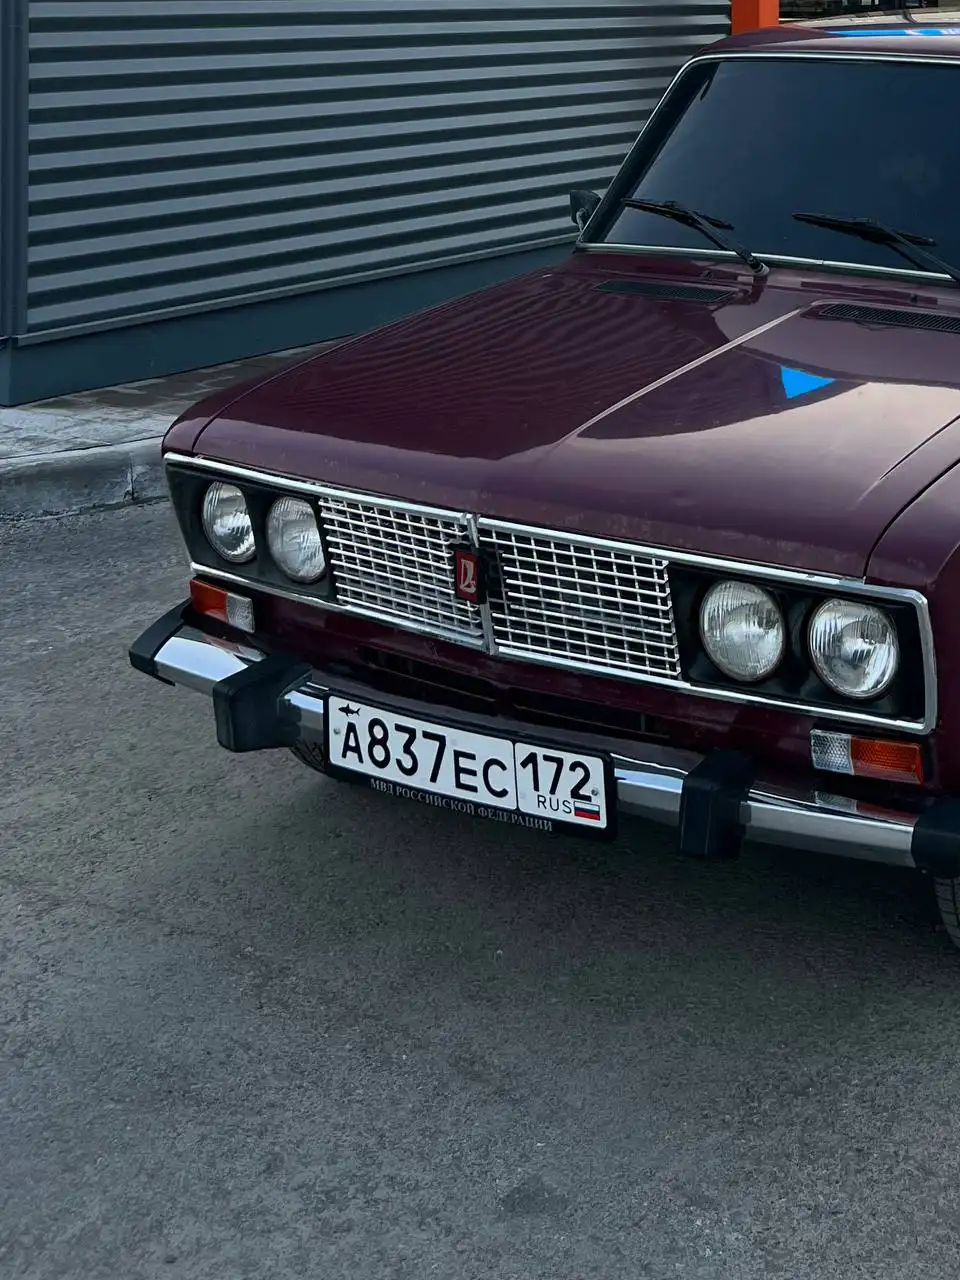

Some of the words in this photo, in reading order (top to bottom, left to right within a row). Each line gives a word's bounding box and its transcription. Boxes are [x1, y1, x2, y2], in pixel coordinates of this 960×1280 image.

[341, 717, 509, 799] А837ЕС
[520, 751, 593, 802] 172
[370, 777, 394, 795] МВД
[396, 786, 475, 816] РОССИЙСКОЙ
[477, 806, 553, 832] ФЕДЕРАЦИИ
[537, 794, 572, 814] RUS
